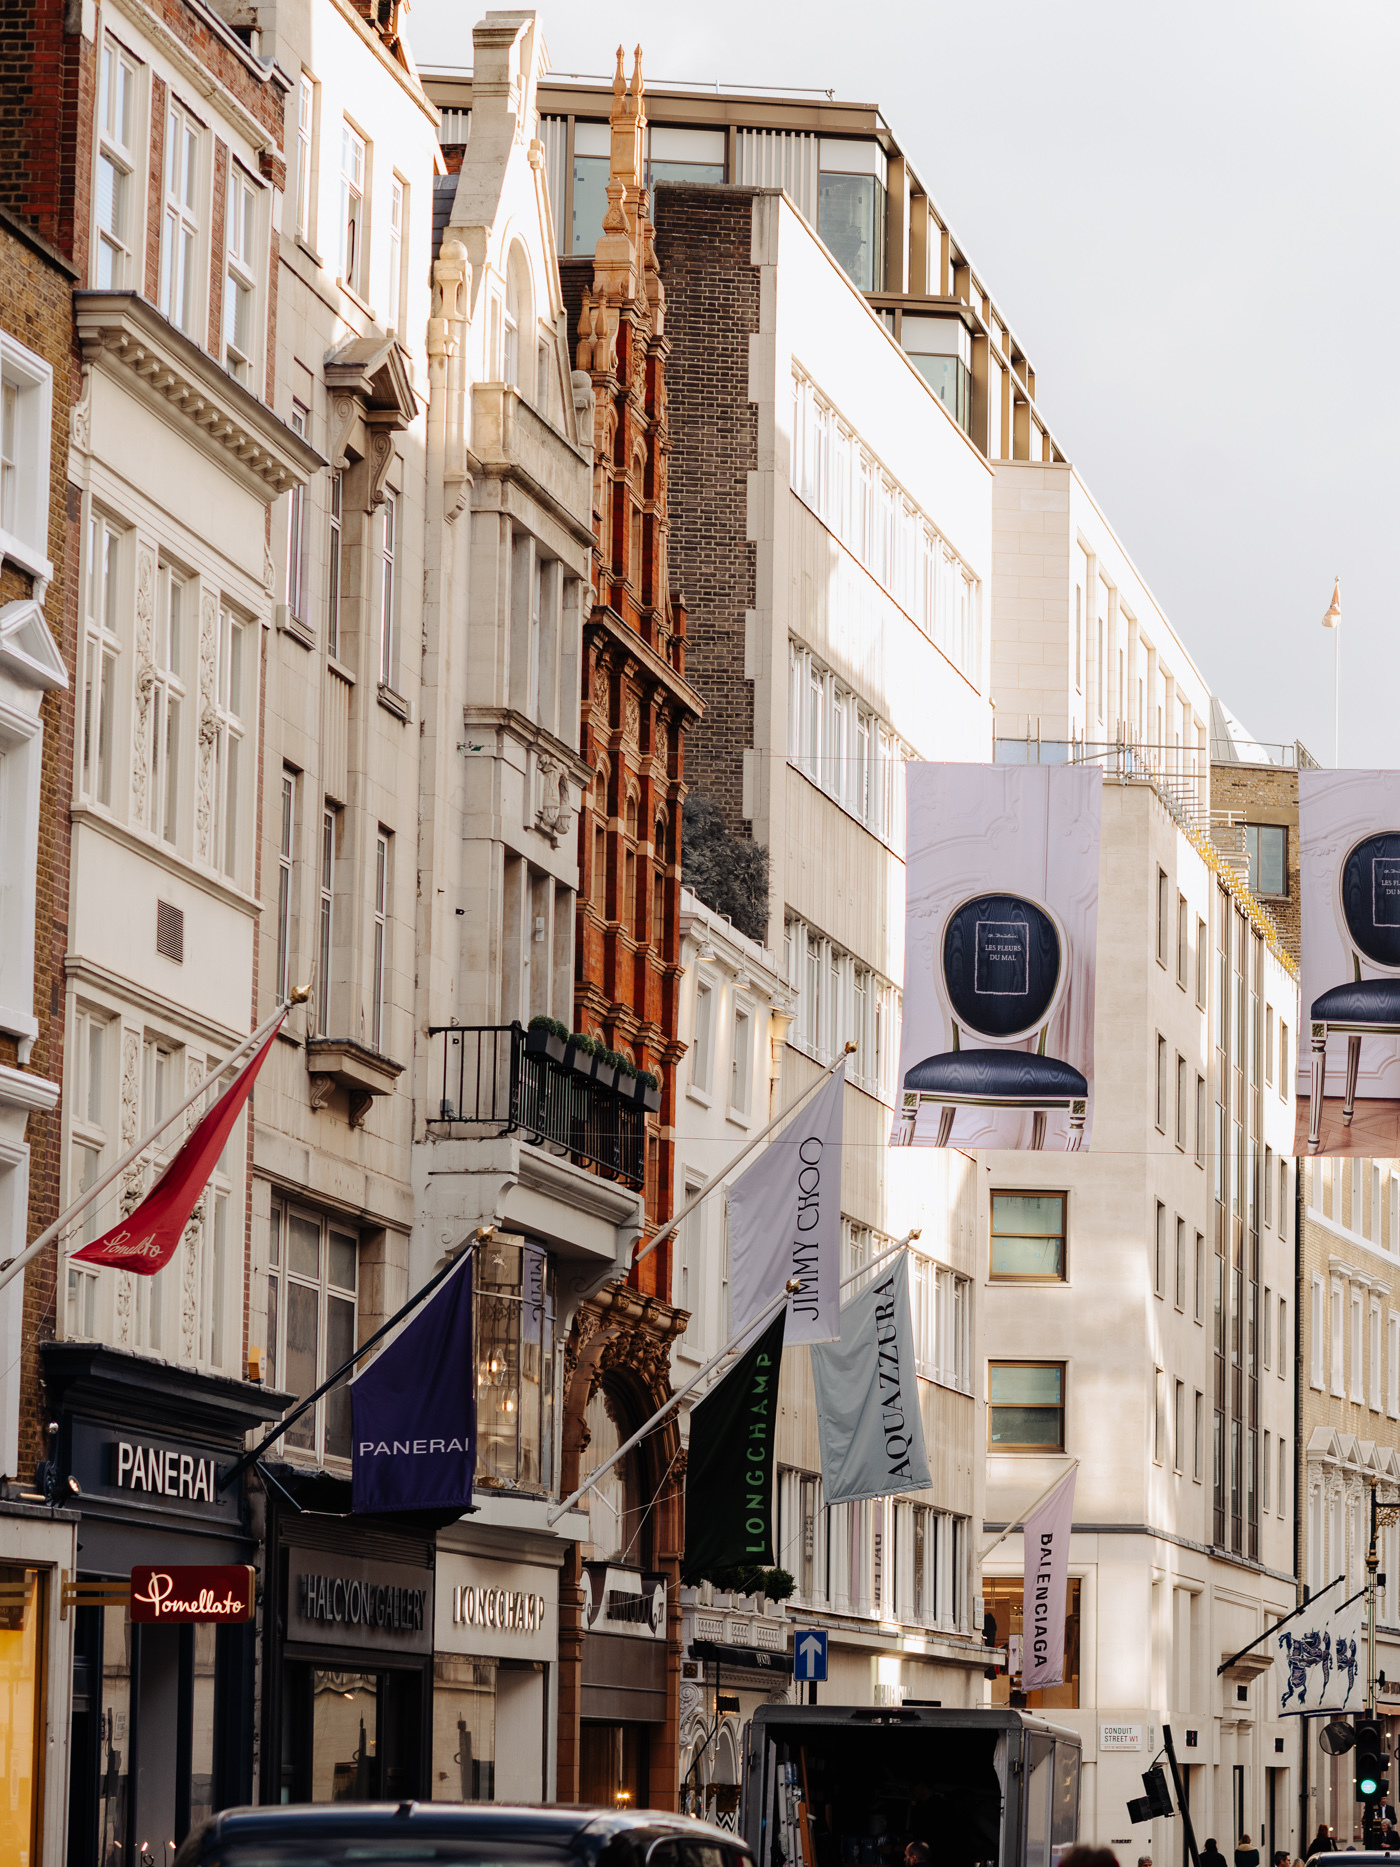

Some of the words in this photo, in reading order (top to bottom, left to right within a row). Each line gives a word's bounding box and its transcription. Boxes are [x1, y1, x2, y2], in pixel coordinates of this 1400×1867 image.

[797, 1136, 824, 1232] CHOO
[792, 1240, 819, 1321] JIMMY
[872, 1274, 913, 1482] AQUAZZURA
[117, 1441, 215, 1503] PANERAI
[359, 1438, 469, 1456] PANERAI
[745, 1352, 773, 1552] LONGCHAMP
[133, 1571, 246, 1617] Pomellato
[306, 1574, 371, 1625] HALCYON
[375, 1584, 427, 1631] GALLERY
[453, 1585, 545, 1631] LONGCHAMP
[1033, 1532, 1053, 1668] BALENCIAGA
[1104, 1727, 1132, 1735] CONDUIT
[1104, 1735, 1128, 1743] STREET
[1129, 1735, 1139, 1743] W1
